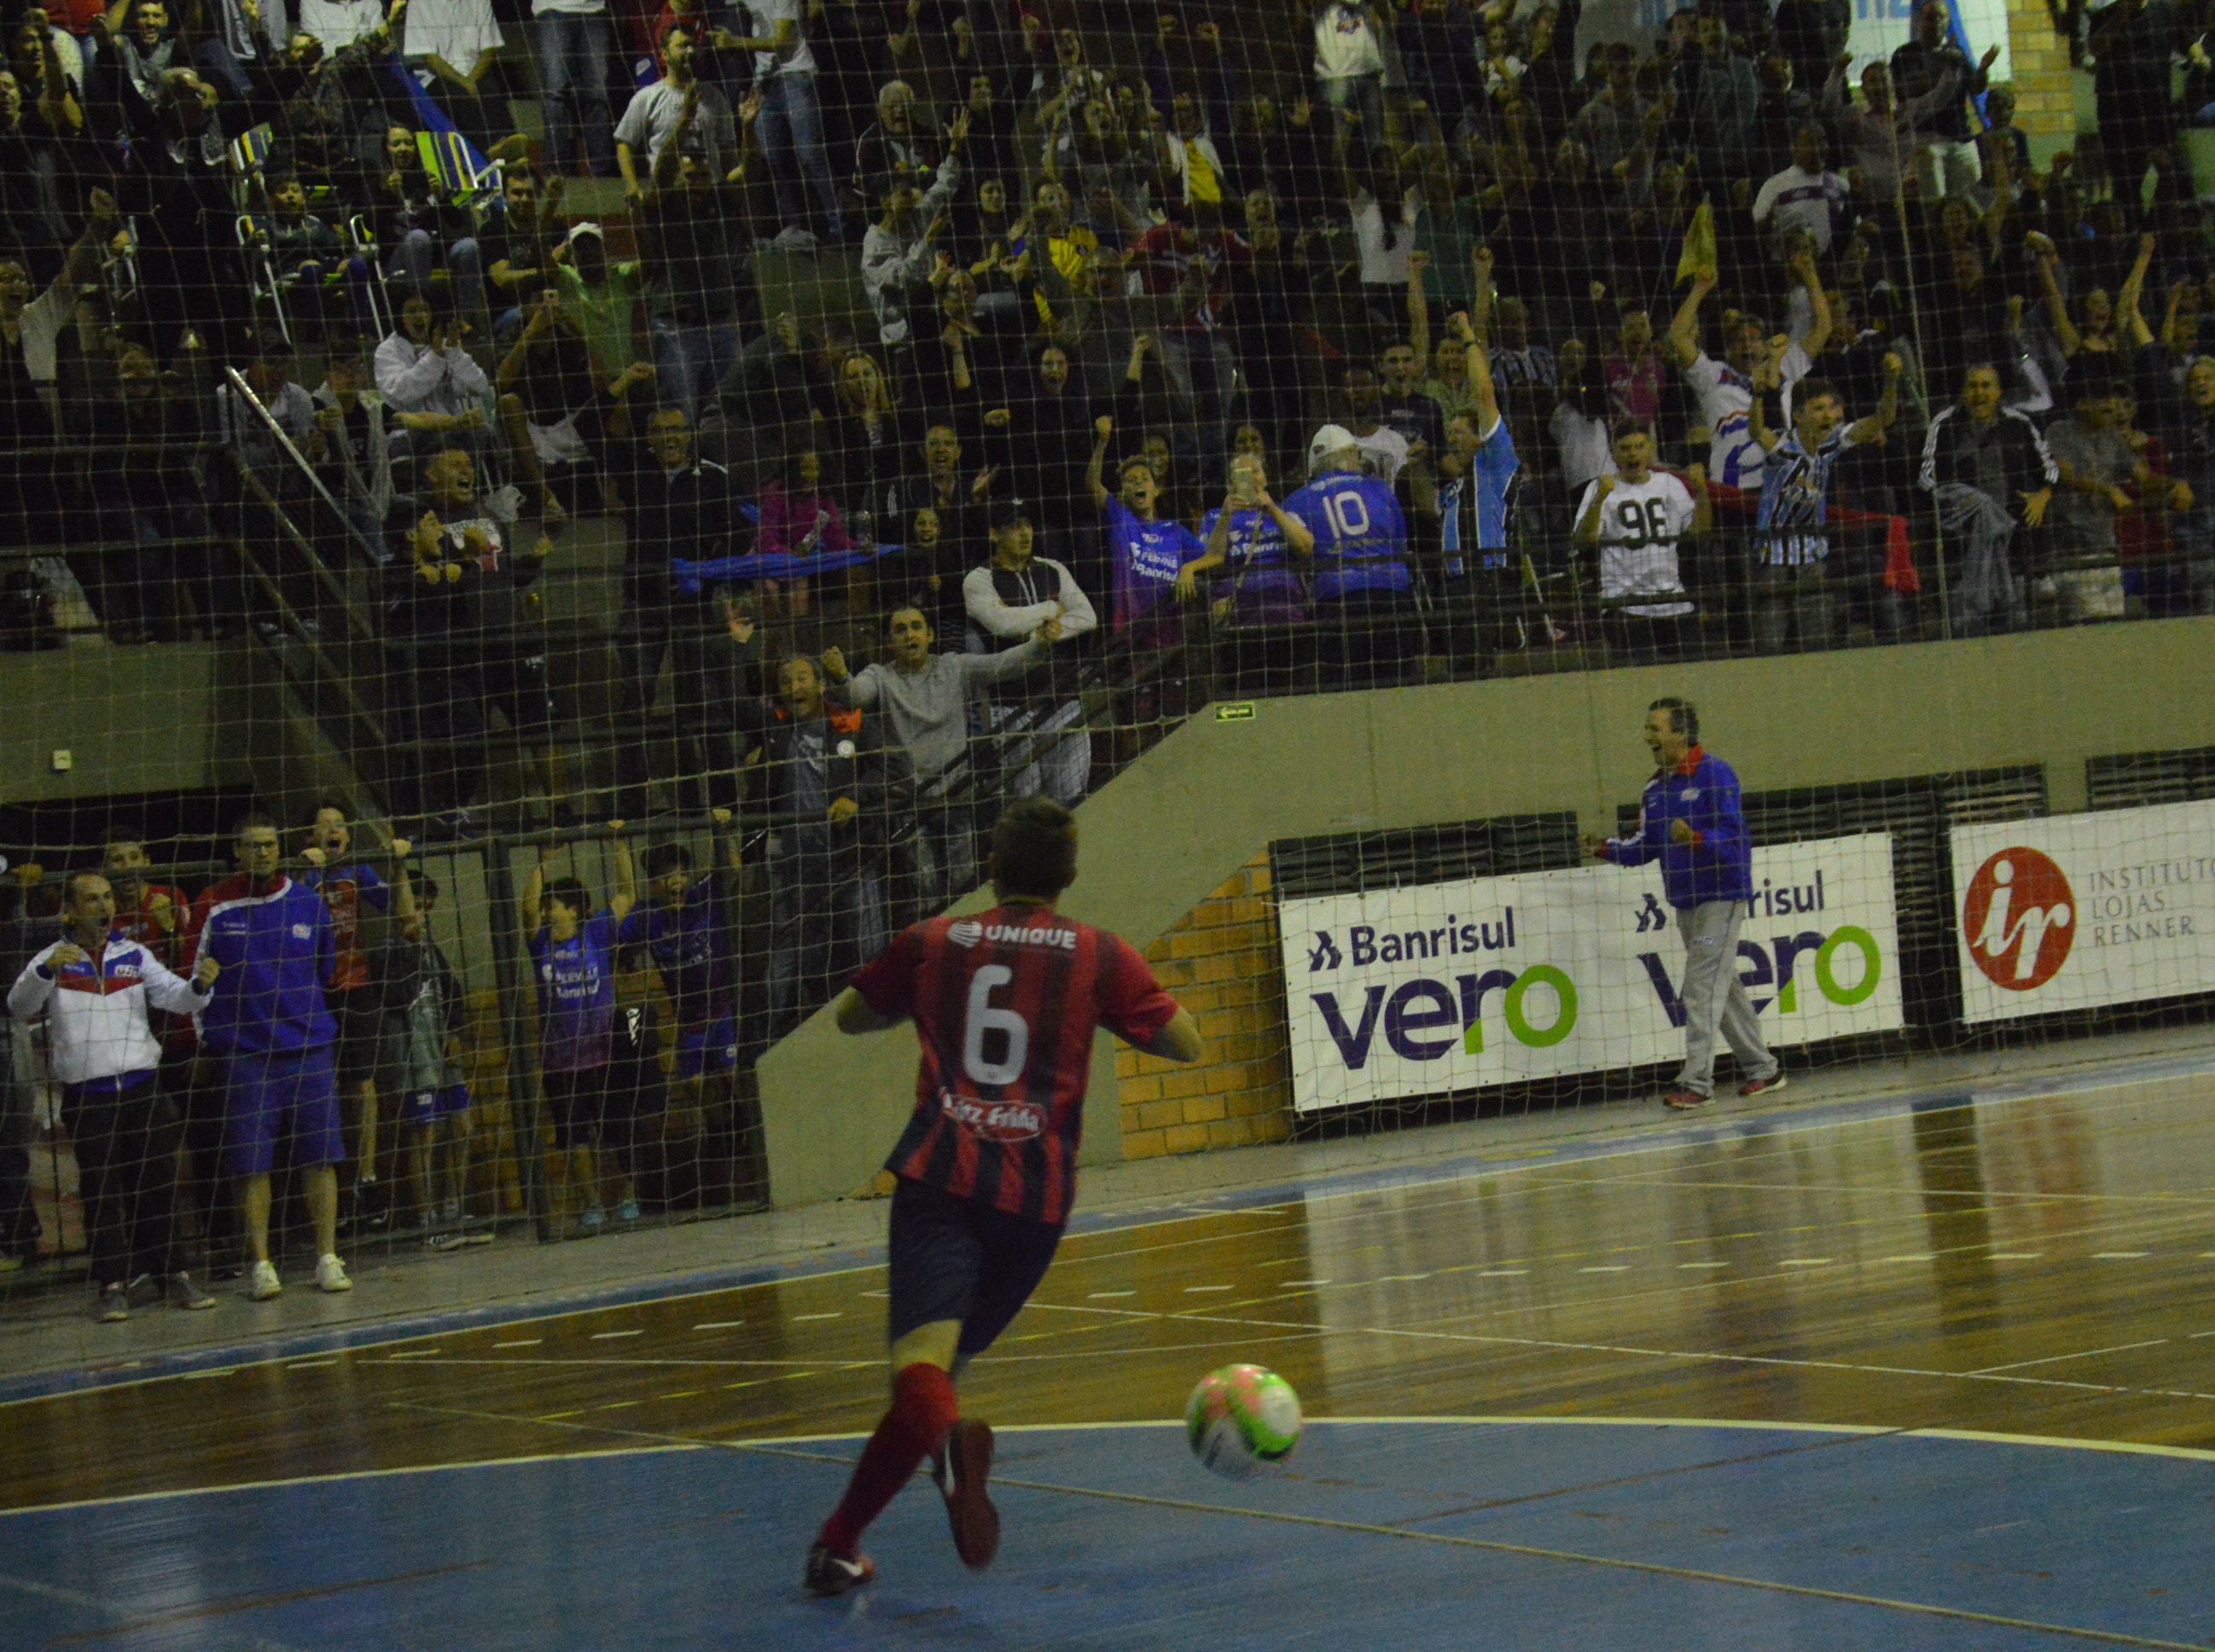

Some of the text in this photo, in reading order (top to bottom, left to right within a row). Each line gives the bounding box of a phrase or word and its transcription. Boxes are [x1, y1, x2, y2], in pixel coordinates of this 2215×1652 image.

[1322, 491, 1369, 539] 10
[1747, 869, 1825, 920] risul
[2092, 890, 2166, 920] LOJAS
[985, 924, 1077, 950] UNIQUE
[1350, 905, 1515, 968] Banrisul
[2094, 915, 2195, 947] RENNER
[962, 964, 1029, 1085] 6
[1310, 963, 1578, 1070] vero
